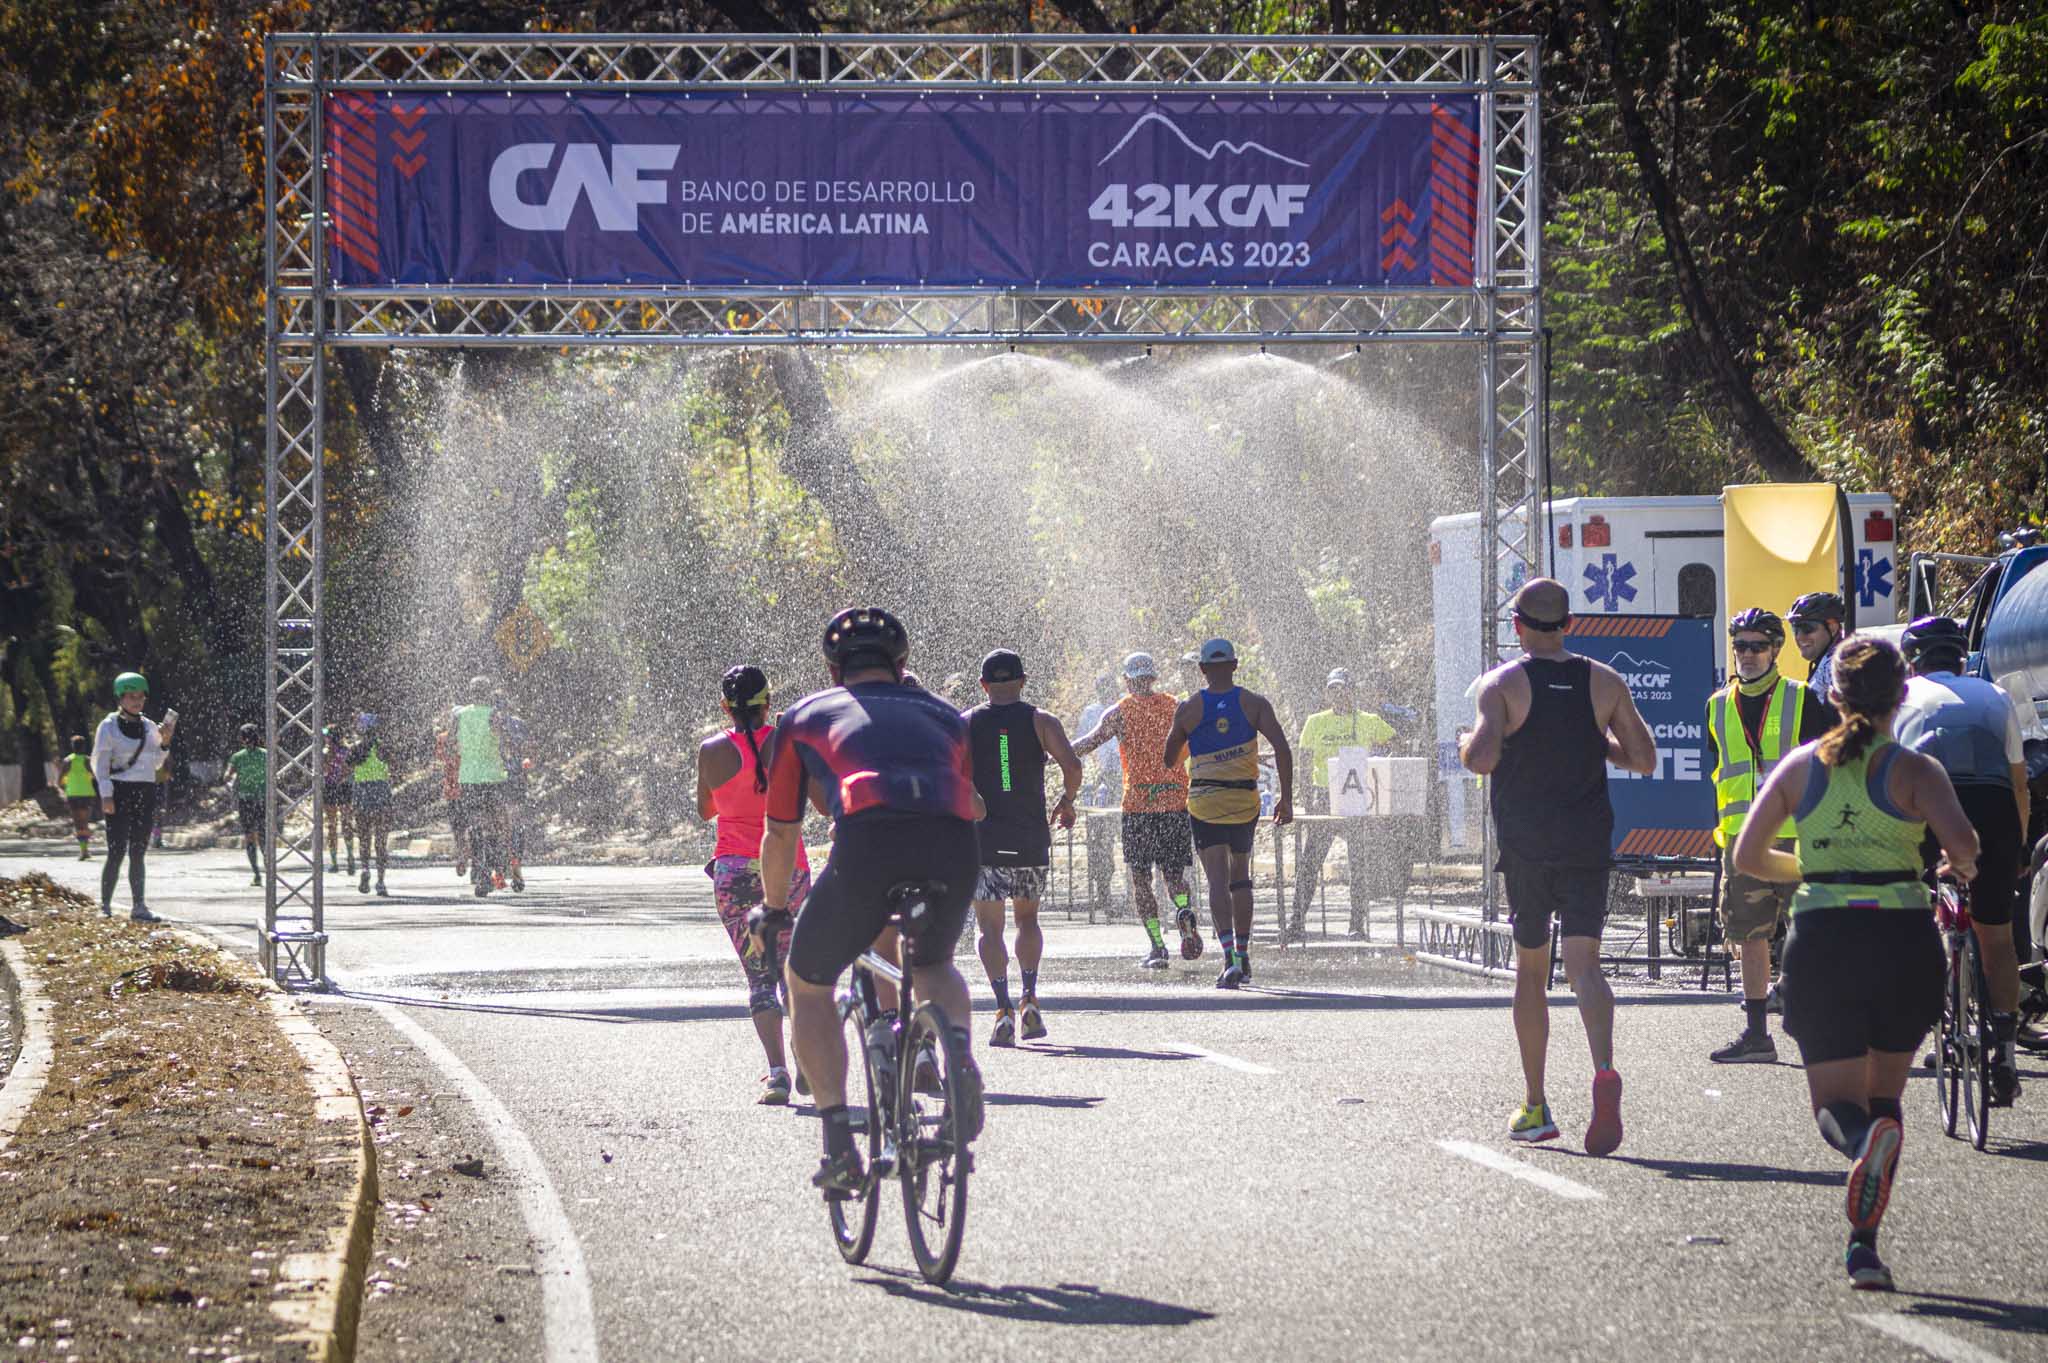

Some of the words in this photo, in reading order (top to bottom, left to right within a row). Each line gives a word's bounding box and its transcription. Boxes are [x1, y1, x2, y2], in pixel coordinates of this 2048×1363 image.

[489, 143, 682, 231] CAF
[682, 180, 767, 202] BANCO
[775, 180, 806, 202] DE
[816, 180, 975, 203] DESARROLLO
[1088, 184, 1310, 228] 42KCAF
[682, 213, 713, 234] DE
[720, 207, 833, 235] AMÉRICA
[840, 213, 929, 235] LATINA
[1087, 242, 1235, 267] CARACAS
[1243, 242, 1311, 267] 2023
[1650, 691, 1672, 700] 2023
